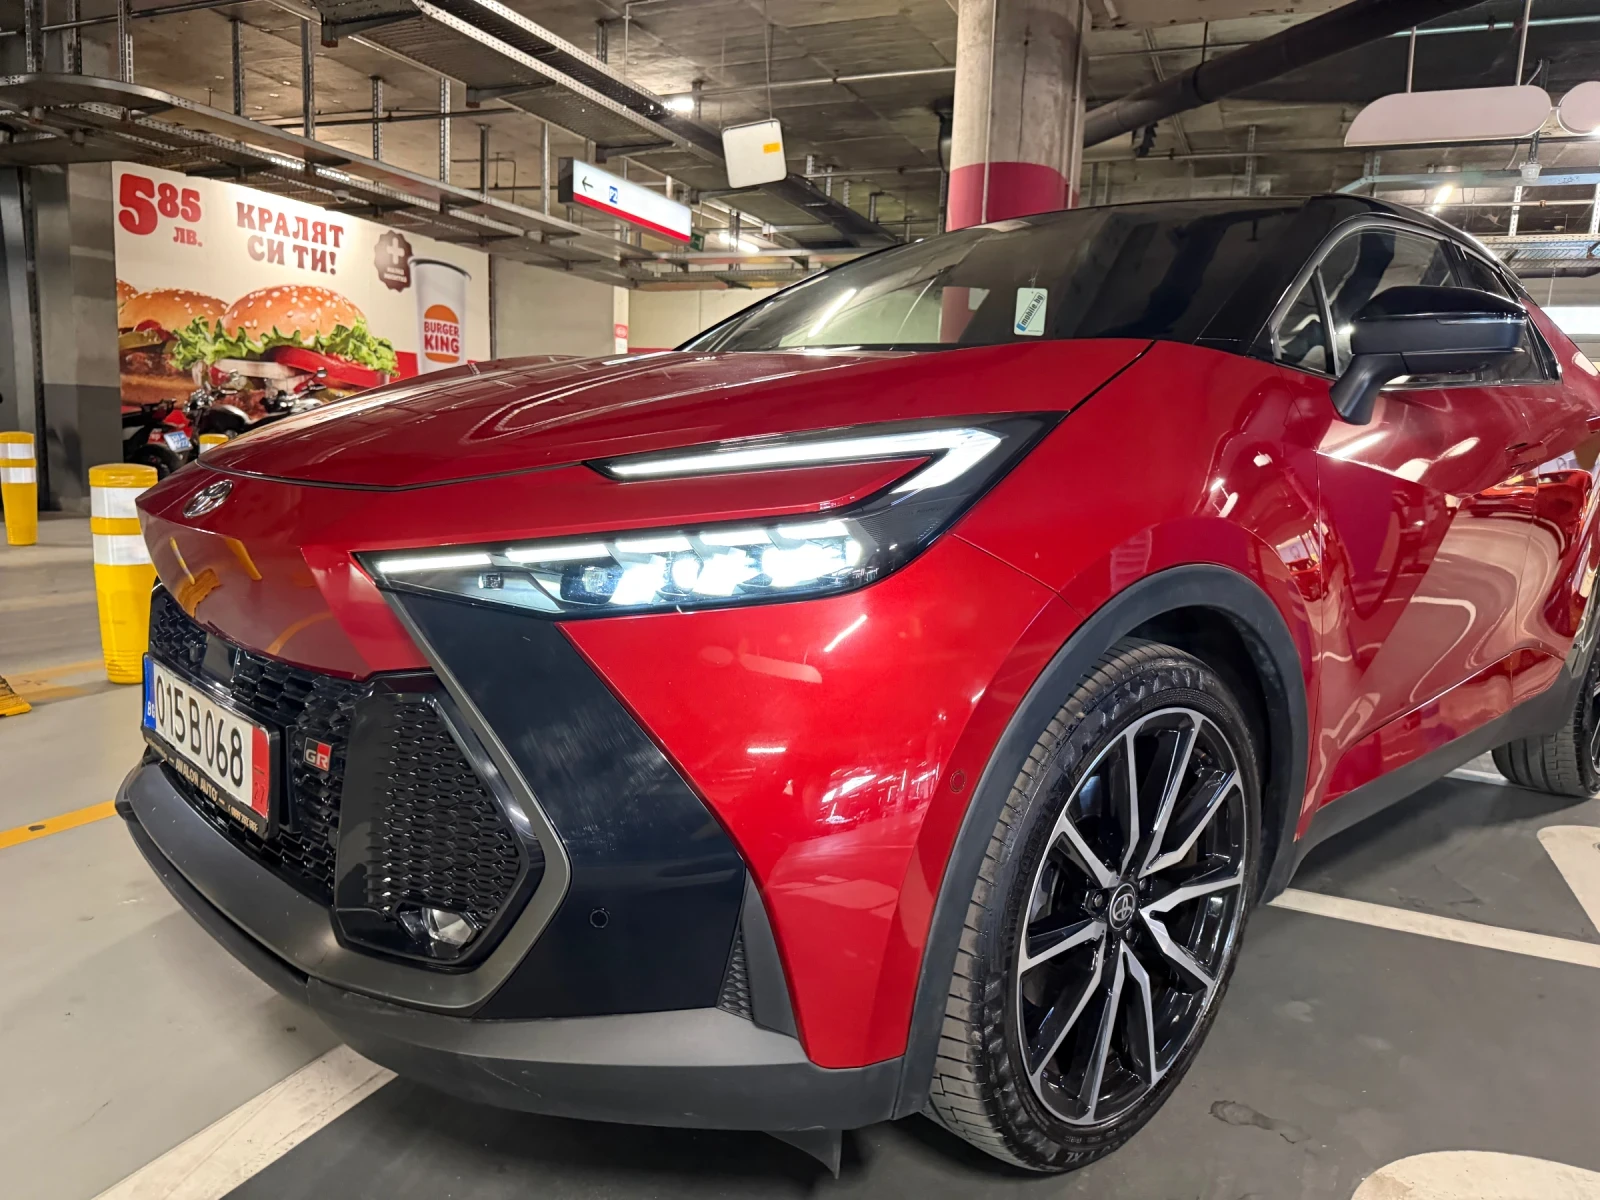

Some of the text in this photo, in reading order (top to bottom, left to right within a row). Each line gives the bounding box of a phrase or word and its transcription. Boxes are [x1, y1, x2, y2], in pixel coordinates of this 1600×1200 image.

[236, 201, 344, 248] КРАЛЯТ
[247, 235, 337, 275] СИ ТИ!
[1021, 294, 1044, 326] mobile.bg
[424, 321, 460, 338] BURGER
[424, 335, 460, 353] KING
[305, 749, 330, 771] GR
[175, 757, 219, 802] AVALON AUTO
